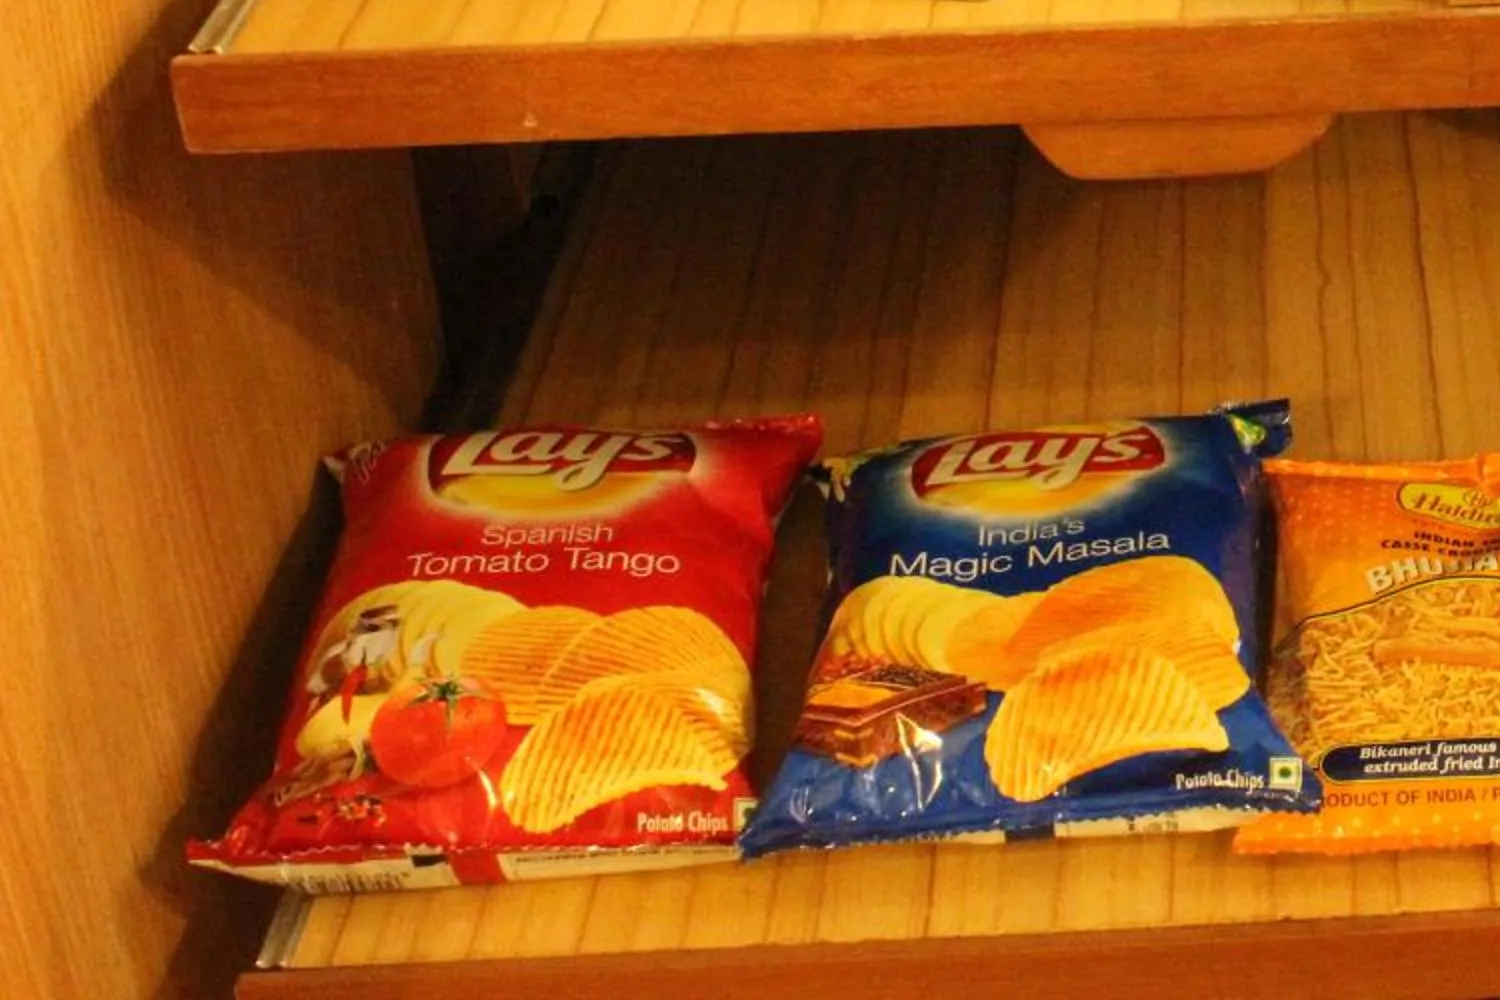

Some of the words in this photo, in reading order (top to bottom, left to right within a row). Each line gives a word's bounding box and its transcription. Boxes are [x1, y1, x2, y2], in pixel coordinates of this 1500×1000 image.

[480, 524, 614, 548] Spanish
[978, 518, 1085, 547] India's
[1381, 538, 1430, 552] CASSE
[1414, 531, 1475, 548] INDIAN
[407, 549, 550, 577] Tomato
[563, 546, 681, 577] Tango
[889, 551, 1013, 582] Magic
[1027, 530, 1170, 568] Masala
[1366, 553, 1499, 595] BHUJIA
[1360, 744, 1431, 760] Bikaneri
[1432, 742, 1497, 757] famous
[1363, 757, 1438, 774] extruded
[1439, 755, 1483, 775] fried
[1175, 771, 1225, 791] Potato
[1226, 768, 1265, 796] Chips
[1322, 790, 1389, 809] ODUCT
[1397, 788, 1422, 806] OF
[1427, 786, 1476, 804] INDIA
[636, 812, 684, 833] Potato
[687, 810, 729, 837] Chips
